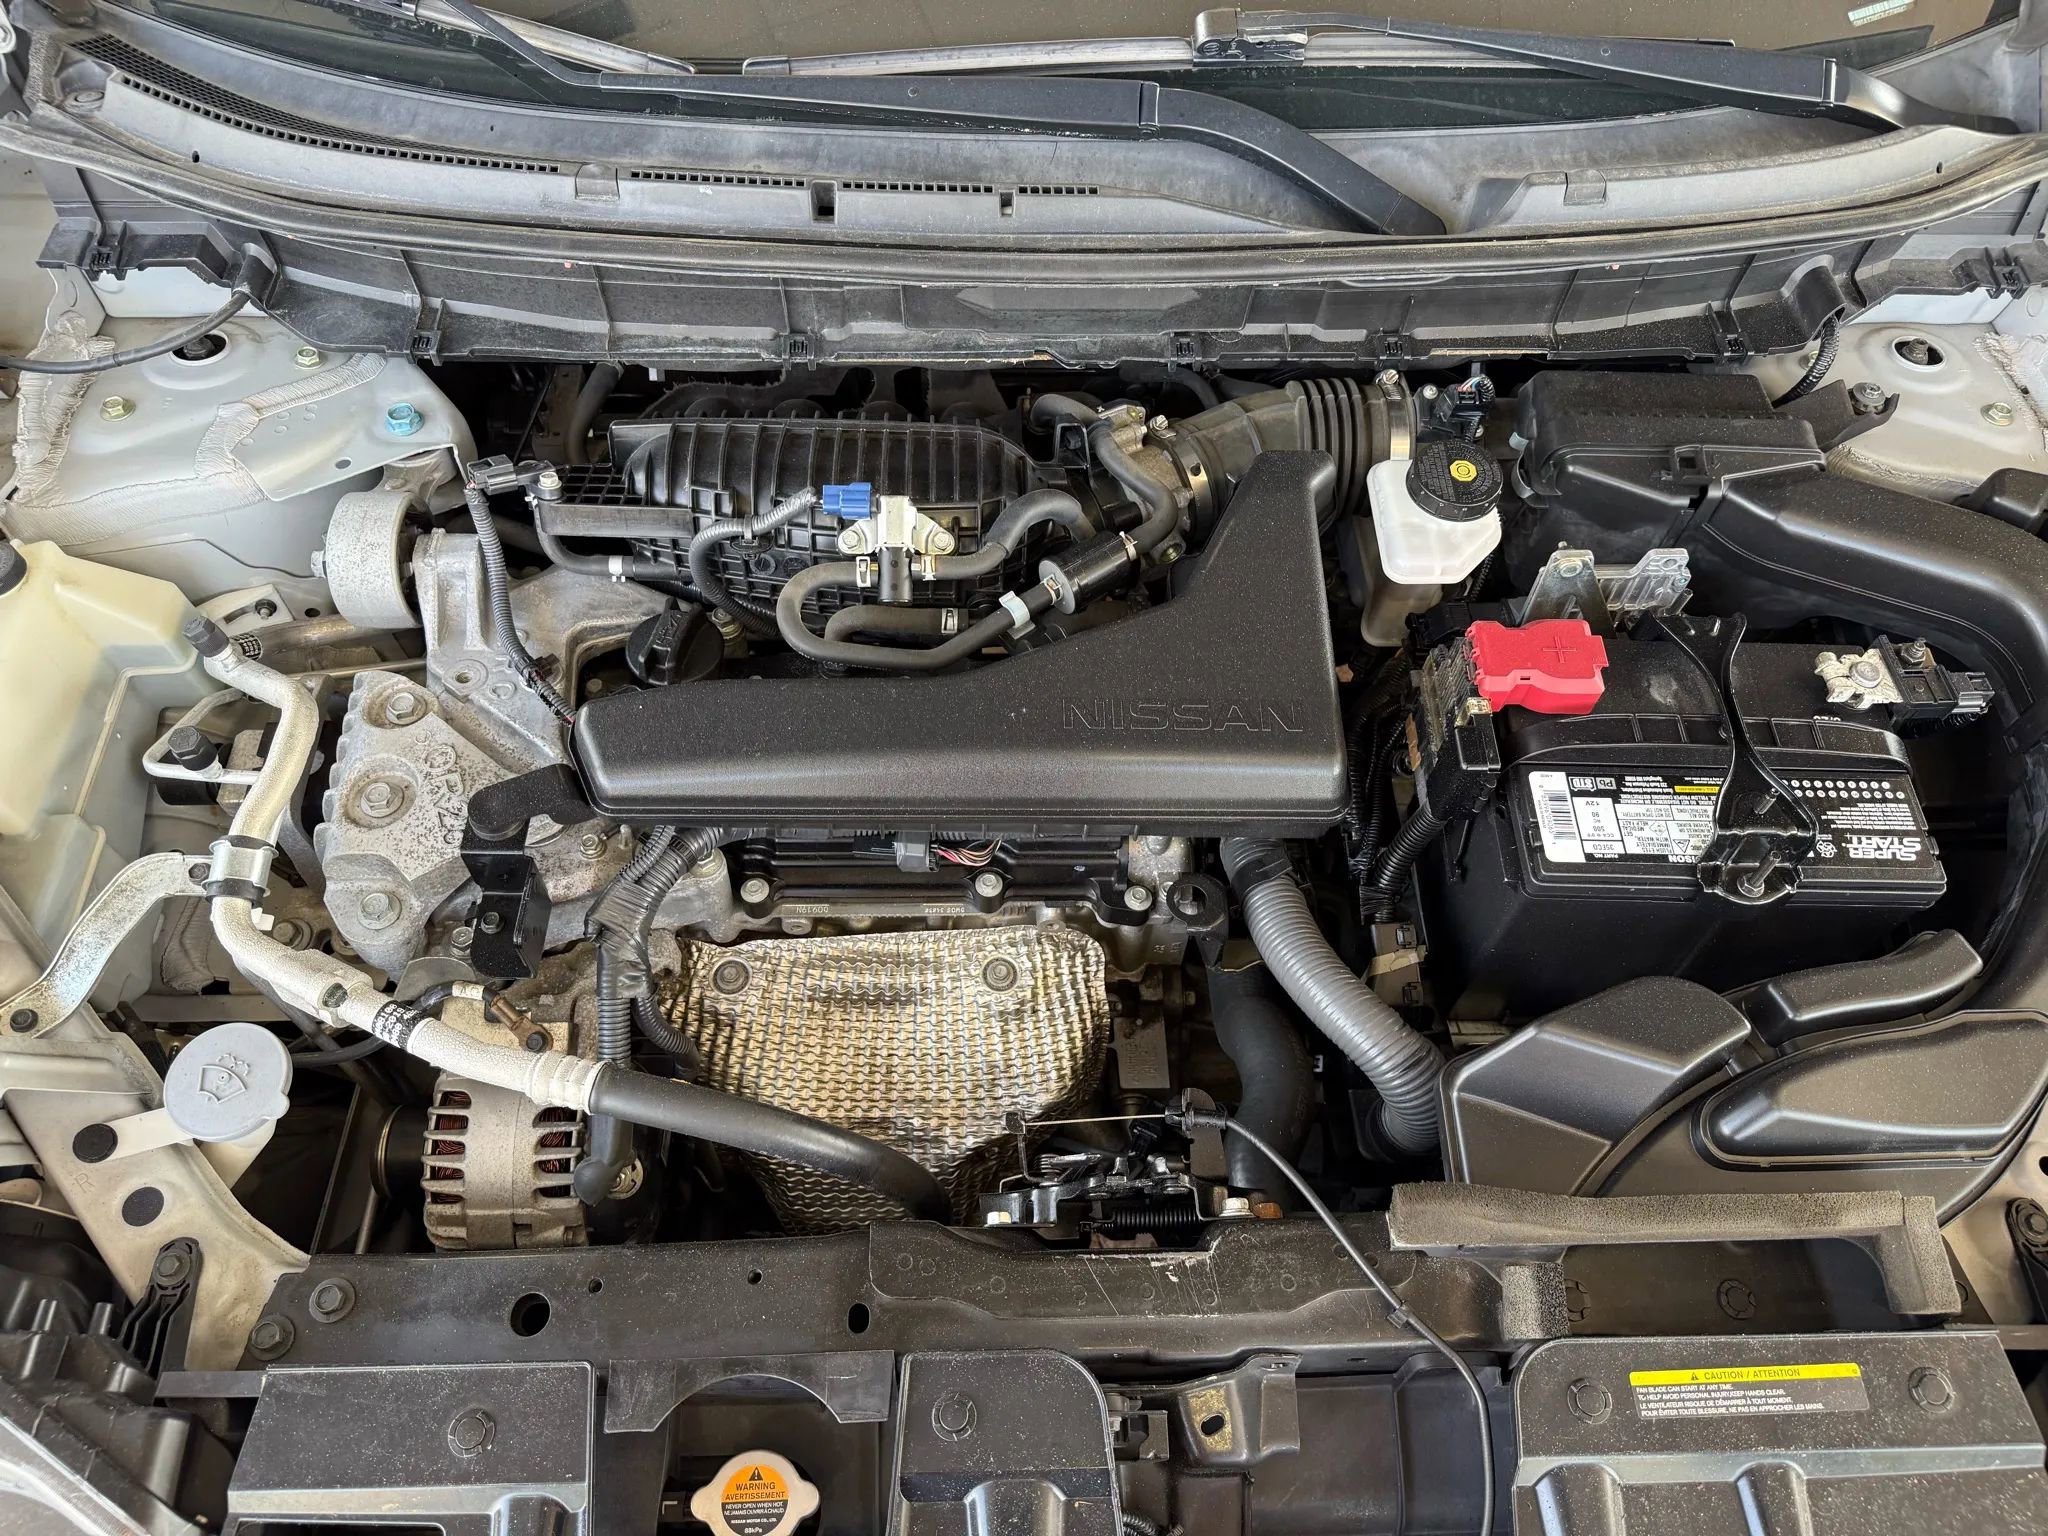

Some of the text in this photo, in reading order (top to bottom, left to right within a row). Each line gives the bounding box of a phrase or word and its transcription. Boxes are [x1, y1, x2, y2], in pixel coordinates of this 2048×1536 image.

[1062, 699, 1303, 732] NISSAN
[1599, 779, 1613, 787] Pb
[1846, 837, 1921, 851] START
[1849, 848, 1916, 861] SUPER
[1704, 1371, 1743, 1380] CAUTION
[1753, 1369, 1800, 1378] ATTENTION
[1715, 1398, 1746, 1406] DÉMARRER
[1659, 1407, 1678, 1416] ÉVITER
[736, 1482, 775, 1491] WARNING
[725, 1491, 785, 1500] AVERTISSEMENT
